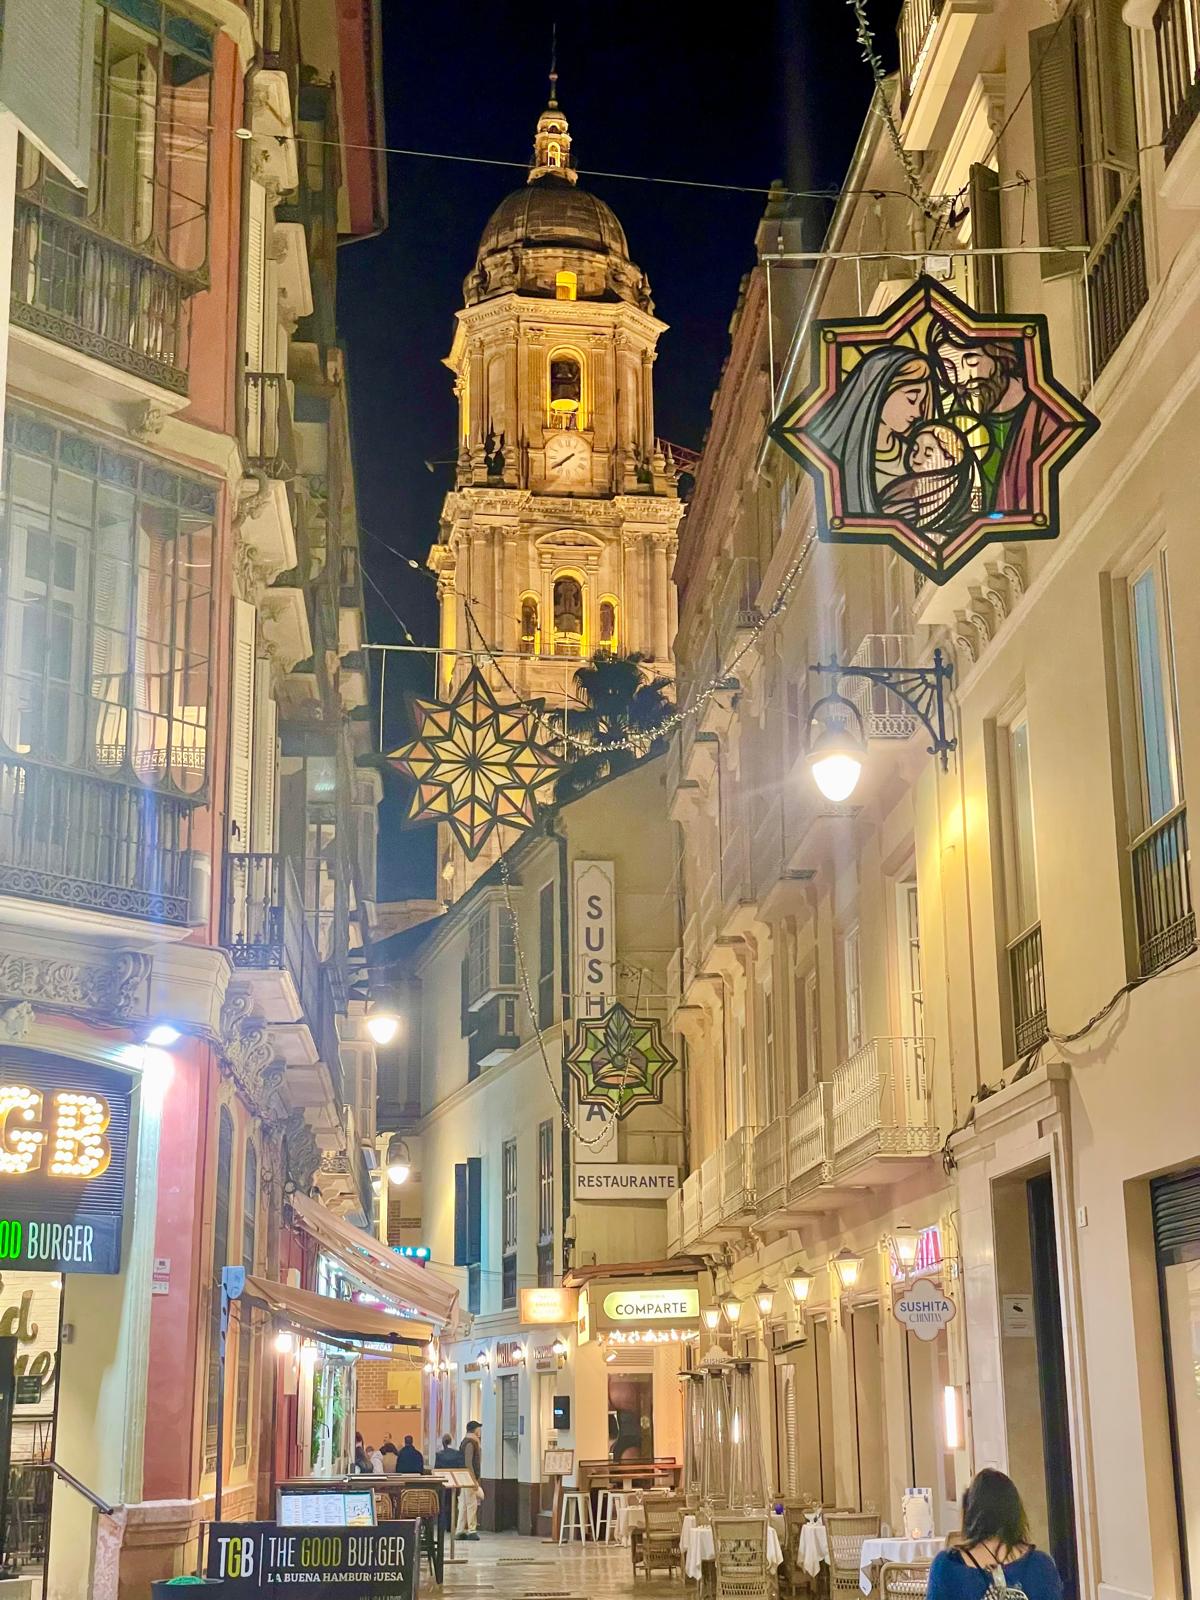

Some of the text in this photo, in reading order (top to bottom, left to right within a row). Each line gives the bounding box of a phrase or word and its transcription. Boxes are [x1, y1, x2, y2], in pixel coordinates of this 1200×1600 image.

[577, 1175, 676, 1189] RESTAURANTE
[27, 1221, 94, 1262] BURGER
[615, 1302, 687, 1315] COMPARTE
[900, 1300, 950, 1312] SUSHITA
[217, 1537, 255, 1578] TGB
[268, 1536, 406, 1567] THE GOOD BURGER
[267, 1573, 282, 1583] LA
[283, 1573, 321, 1583] BUENA
